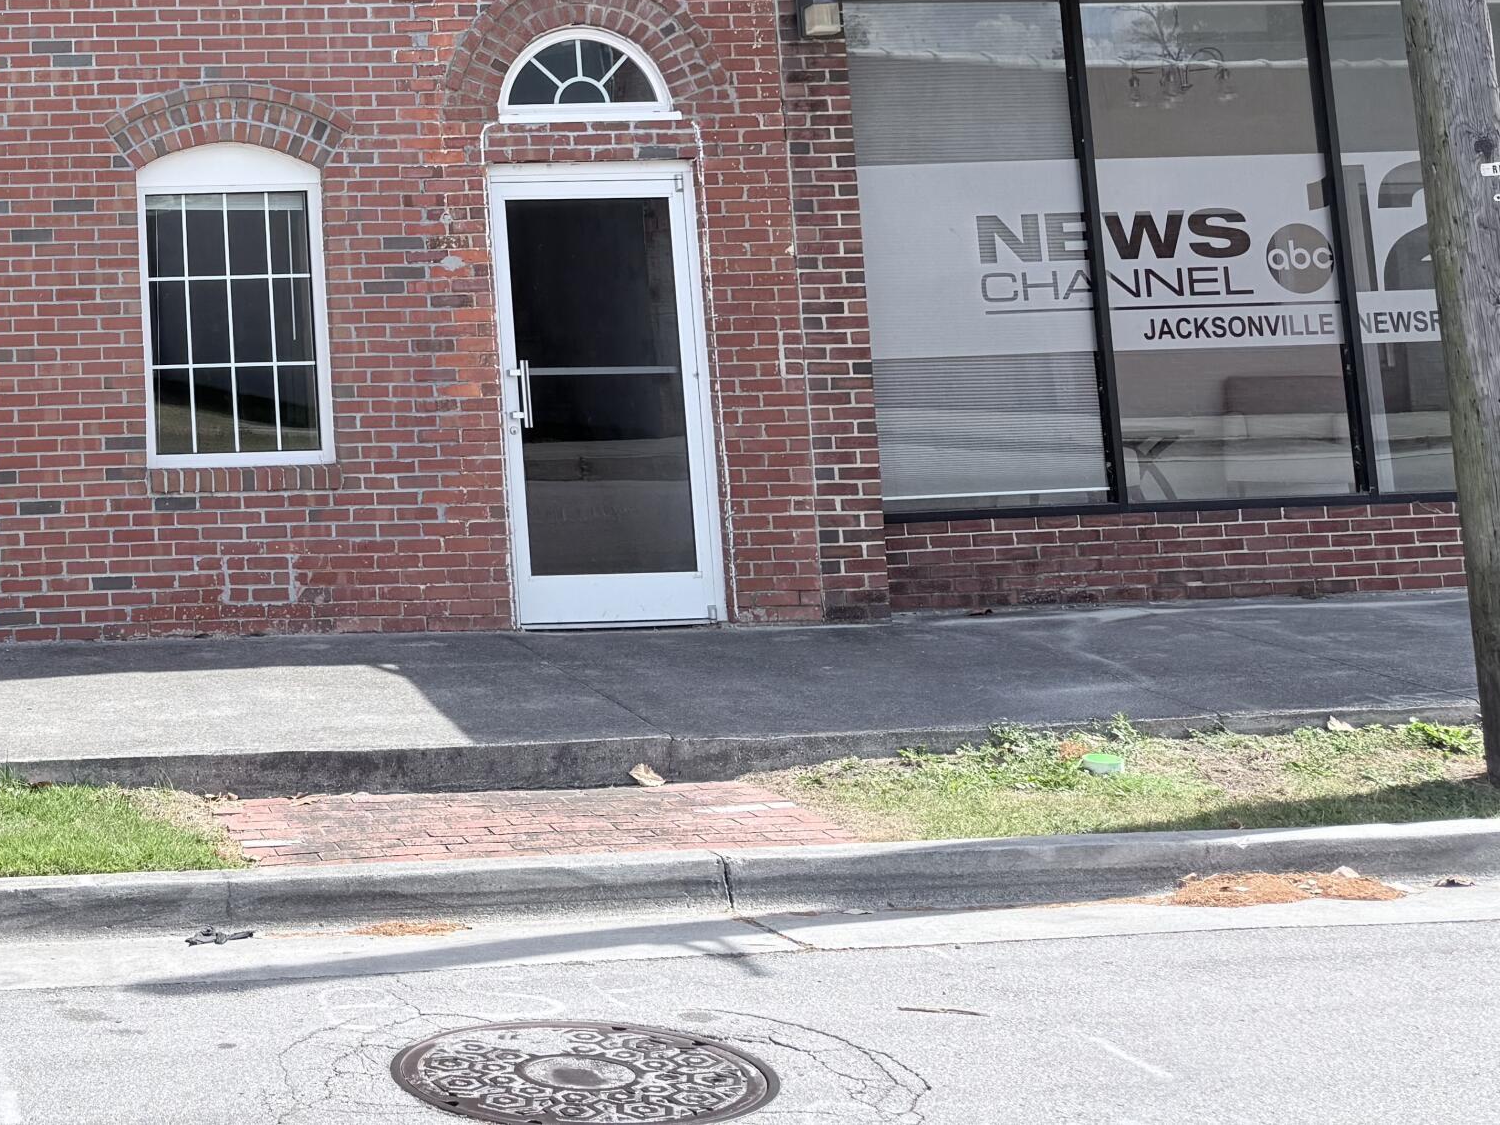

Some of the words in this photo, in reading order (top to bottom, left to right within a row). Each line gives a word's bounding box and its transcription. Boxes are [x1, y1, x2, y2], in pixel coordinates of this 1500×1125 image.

[1492, 164, 1500, 174] R
[976, 208, 1251, 264] NEWS
[1267, 239, 1334, 273] abc
[981, 266, 1254, 303] CHANNEL
[1144, 313, 1335, 341] JACKSONVILLE
